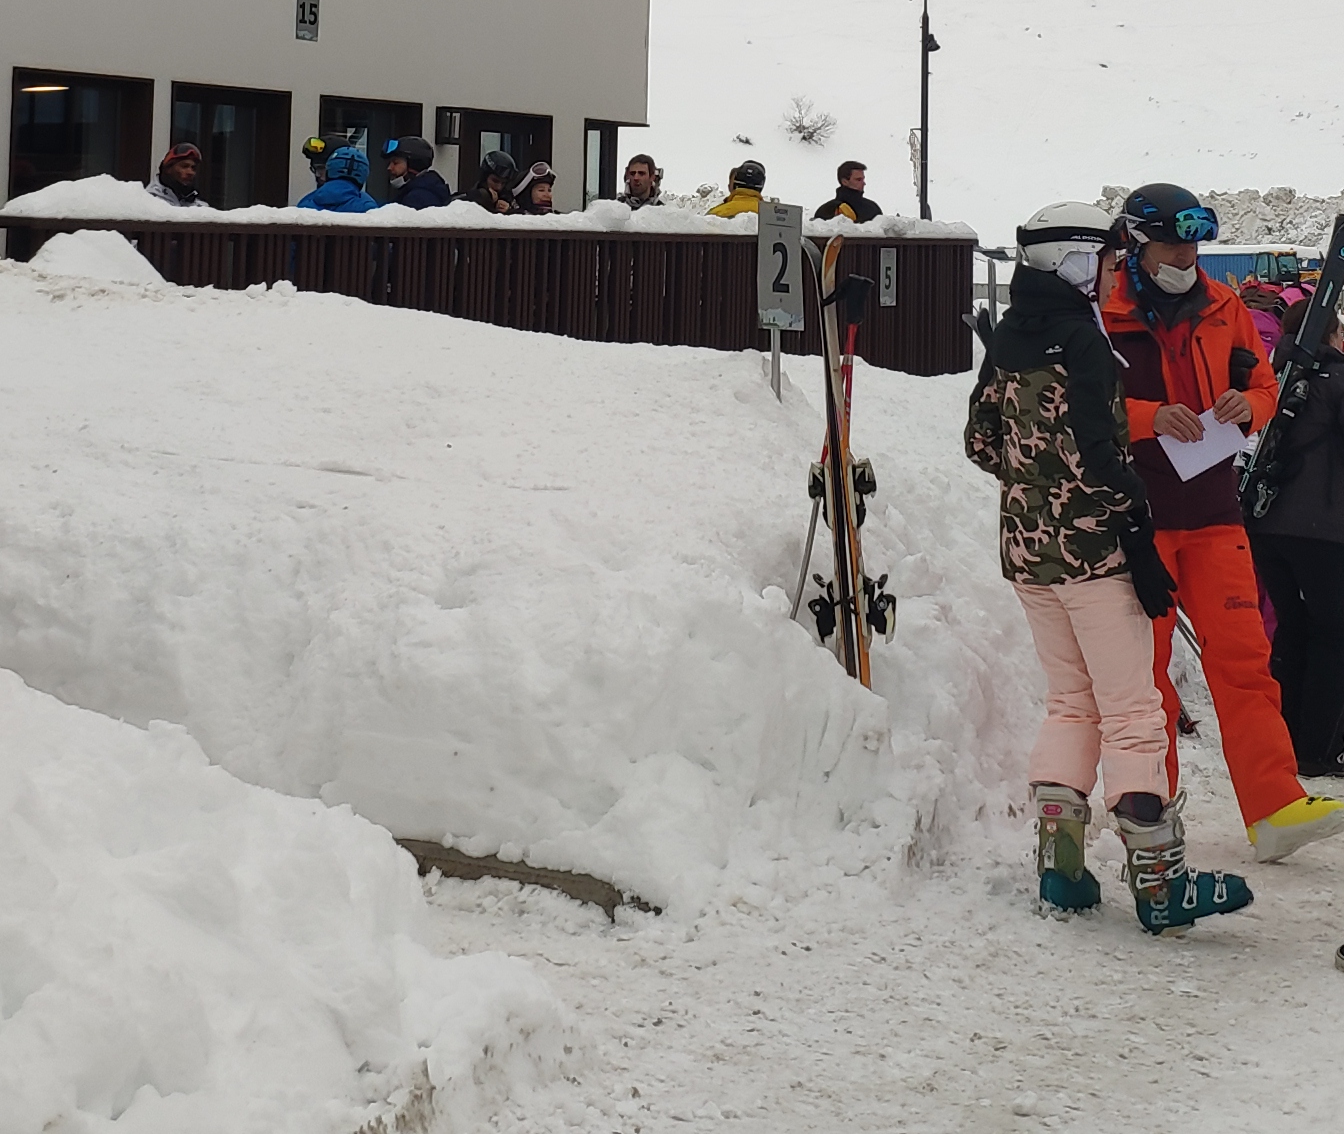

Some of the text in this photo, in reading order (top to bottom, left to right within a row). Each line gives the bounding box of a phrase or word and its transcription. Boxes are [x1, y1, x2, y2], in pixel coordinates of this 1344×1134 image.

[299, 1, 318, 26] 15
[772, 241, 791, 294] 2
[884, 266, 892, 291] 5
